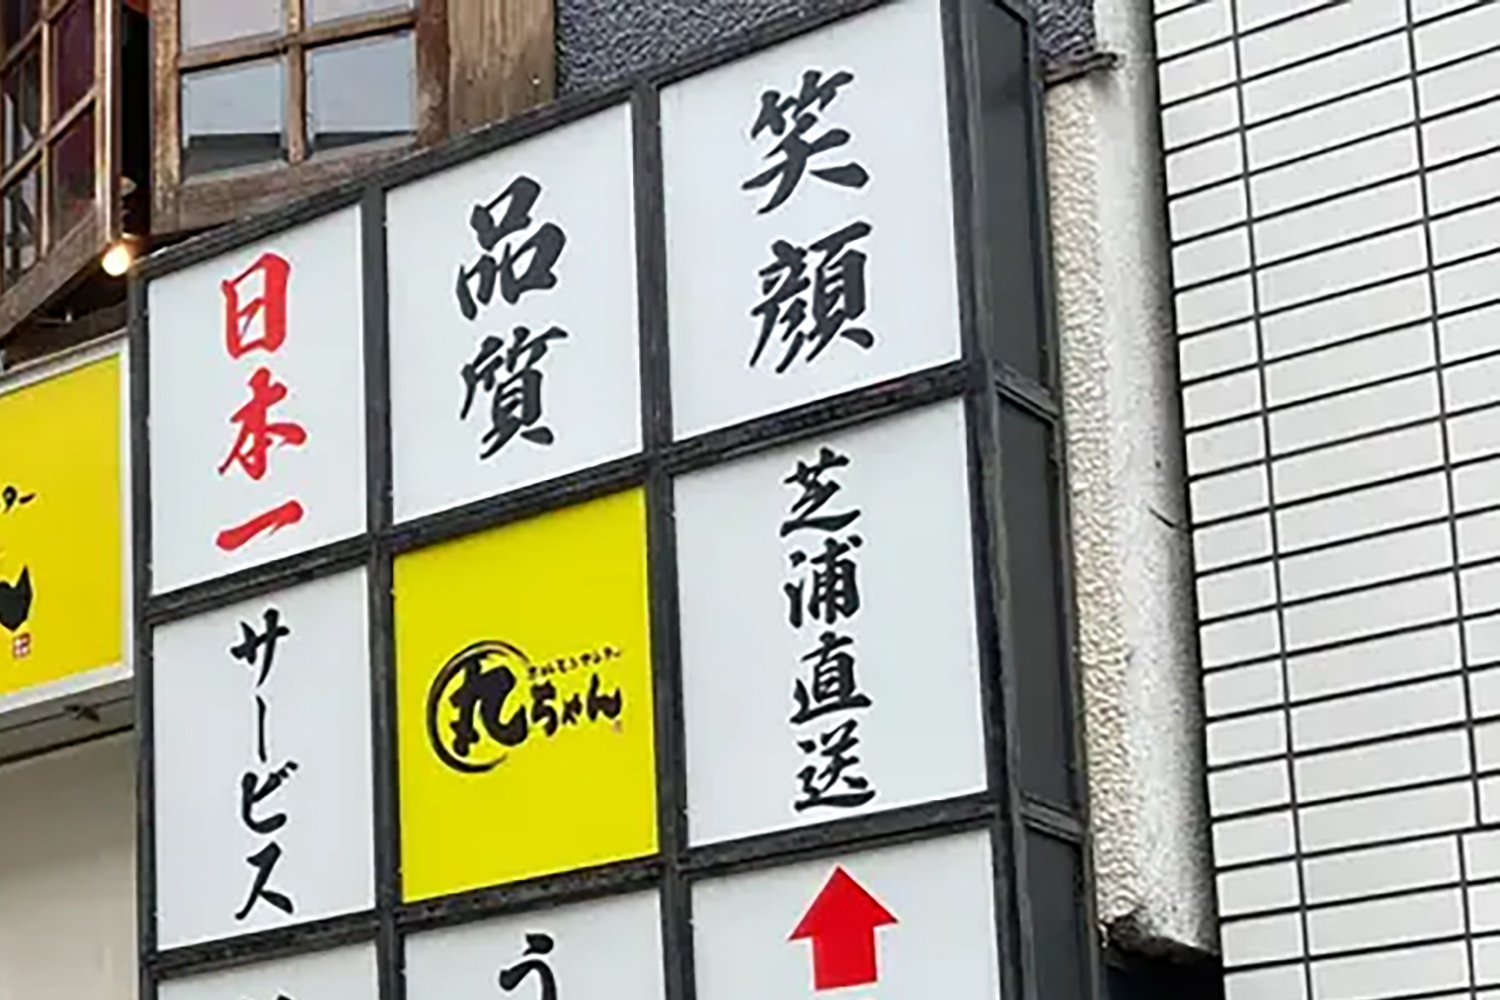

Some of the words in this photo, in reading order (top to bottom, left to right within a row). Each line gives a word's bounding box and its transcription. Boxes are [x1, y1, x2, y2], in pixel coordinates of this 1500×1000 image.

[456, 176, 569, 460] 品質
[741, 69, 875, 374] 笑顔
[215, 252, 306, 553] 日本一
[229, 609, 300, 922] サービス
[448, 650, 622, 758] 丸ちゃん
[780, 445, 877, 813] 芝浦直送
